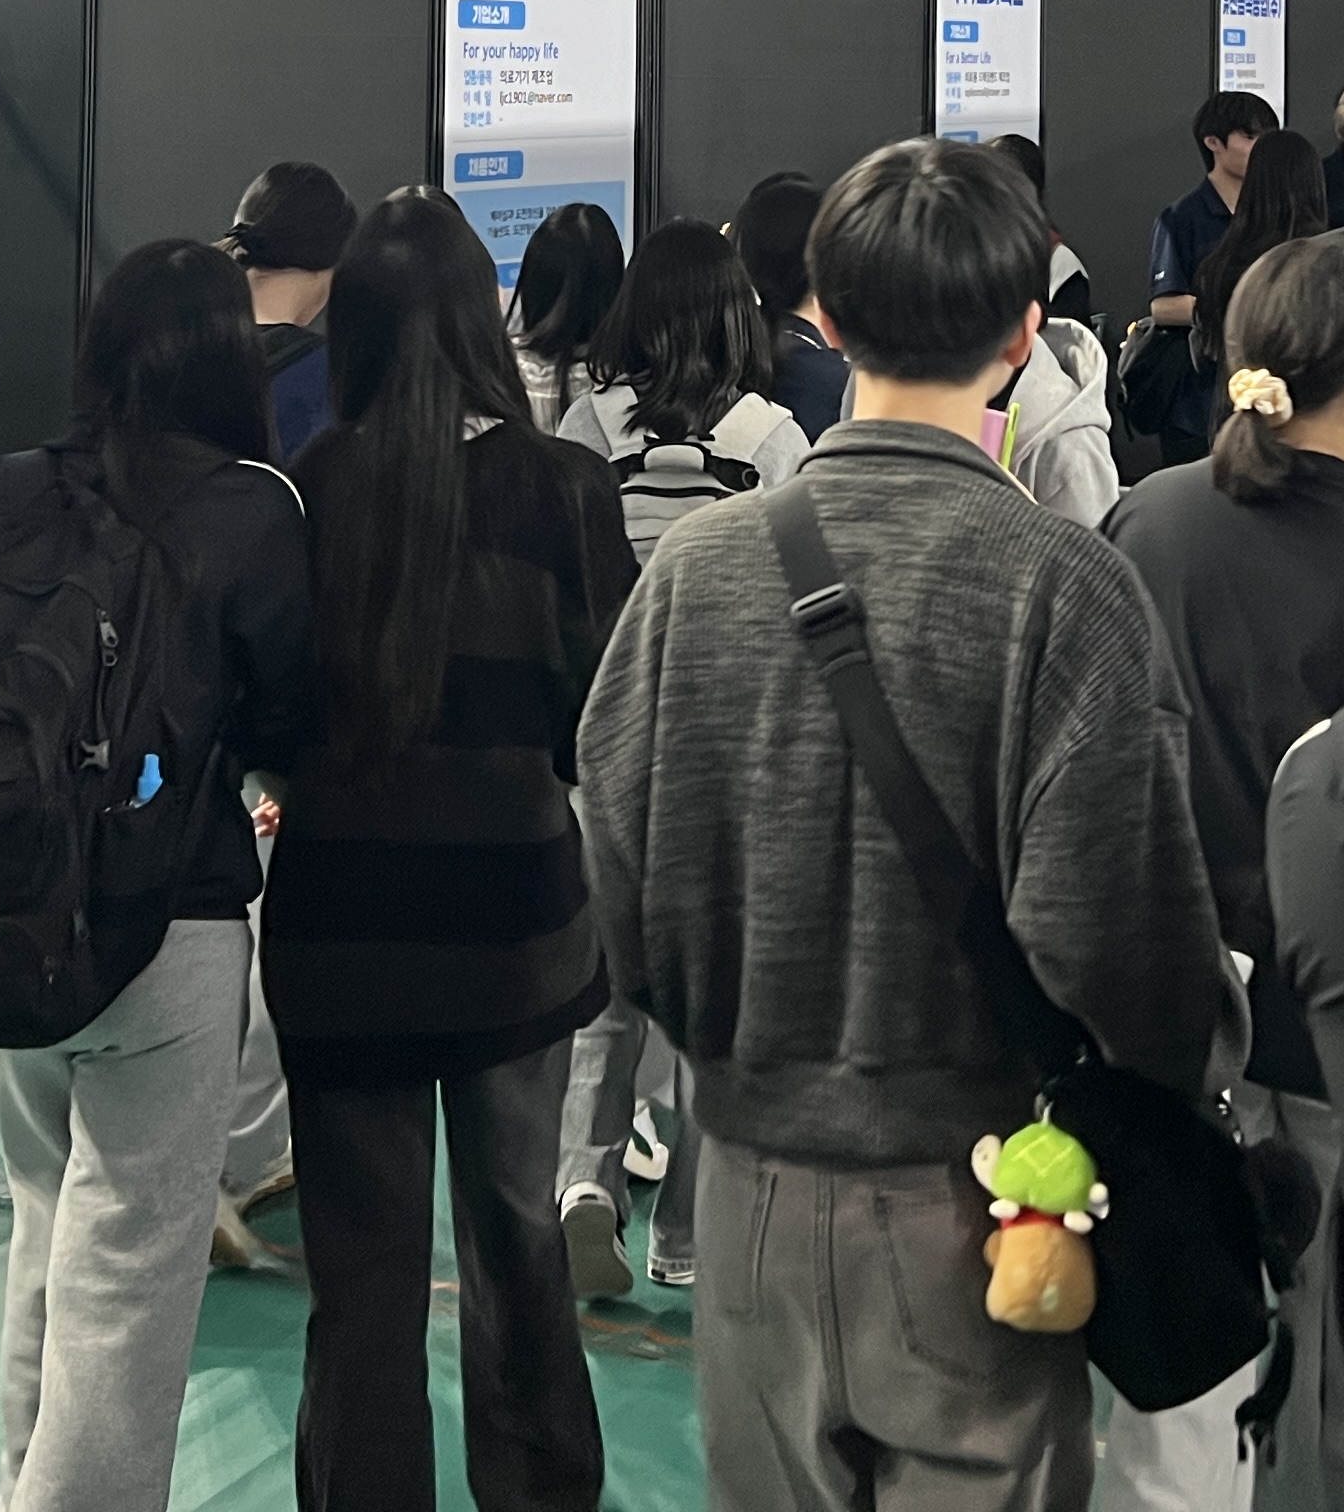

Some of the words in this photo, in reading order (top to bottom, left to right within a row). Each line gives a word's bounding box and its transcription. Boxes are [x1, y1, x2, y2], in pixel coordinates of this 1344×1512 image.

[471, 4, 510, 25] 기업소개
[463, 42, 480, 59] For
[482, 45, 507, 62] your
[509, 42, 541, 62] happy
[543, 42, 559, 59] life
[499, 69, 530, 85] 의료기기
[531, 69, 554, 86] 제조업
